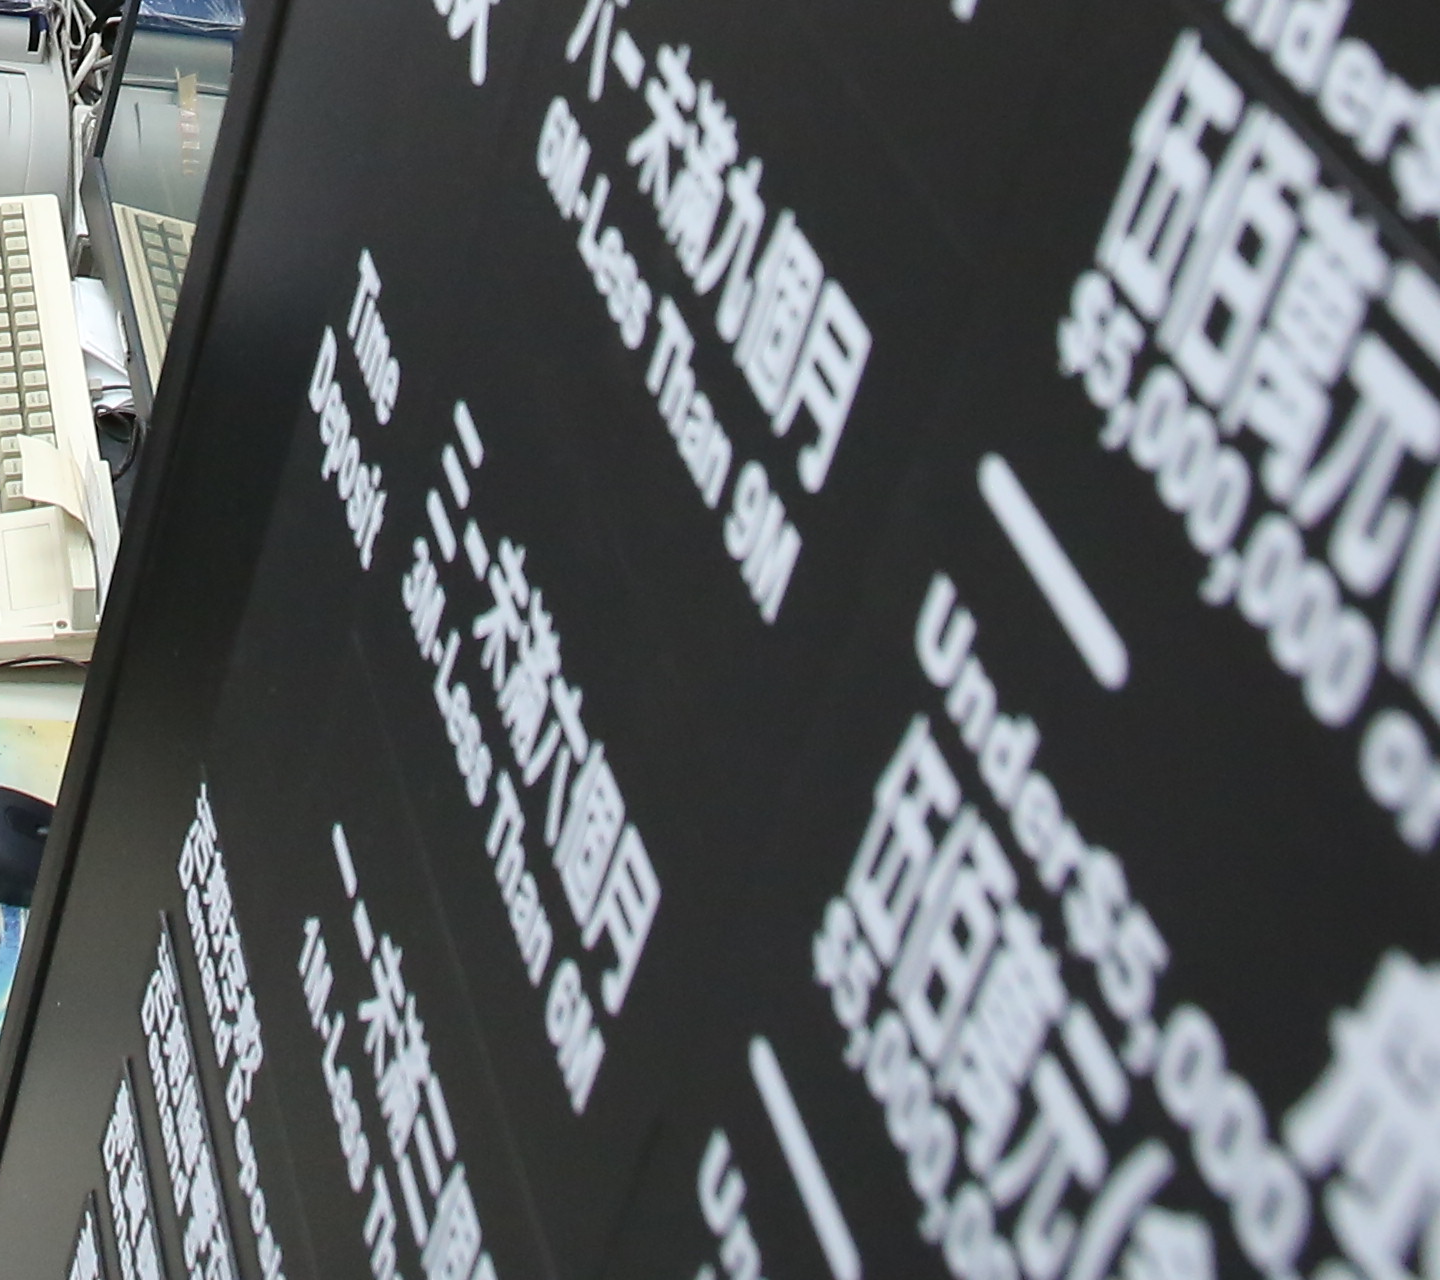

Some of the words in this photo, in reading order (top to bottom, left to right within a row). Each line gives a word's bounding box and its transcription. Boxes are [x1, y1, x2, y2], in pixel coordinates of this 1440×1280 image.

[307, 326, 388, 570] Deposit
[349, 247, 402, 425] Time
[645, 296, 730, 510] Than
[722, 462, 804, 624] 9M
[485, 770, 552, 988] Than
[544, 958, 606, 1115] 6M
